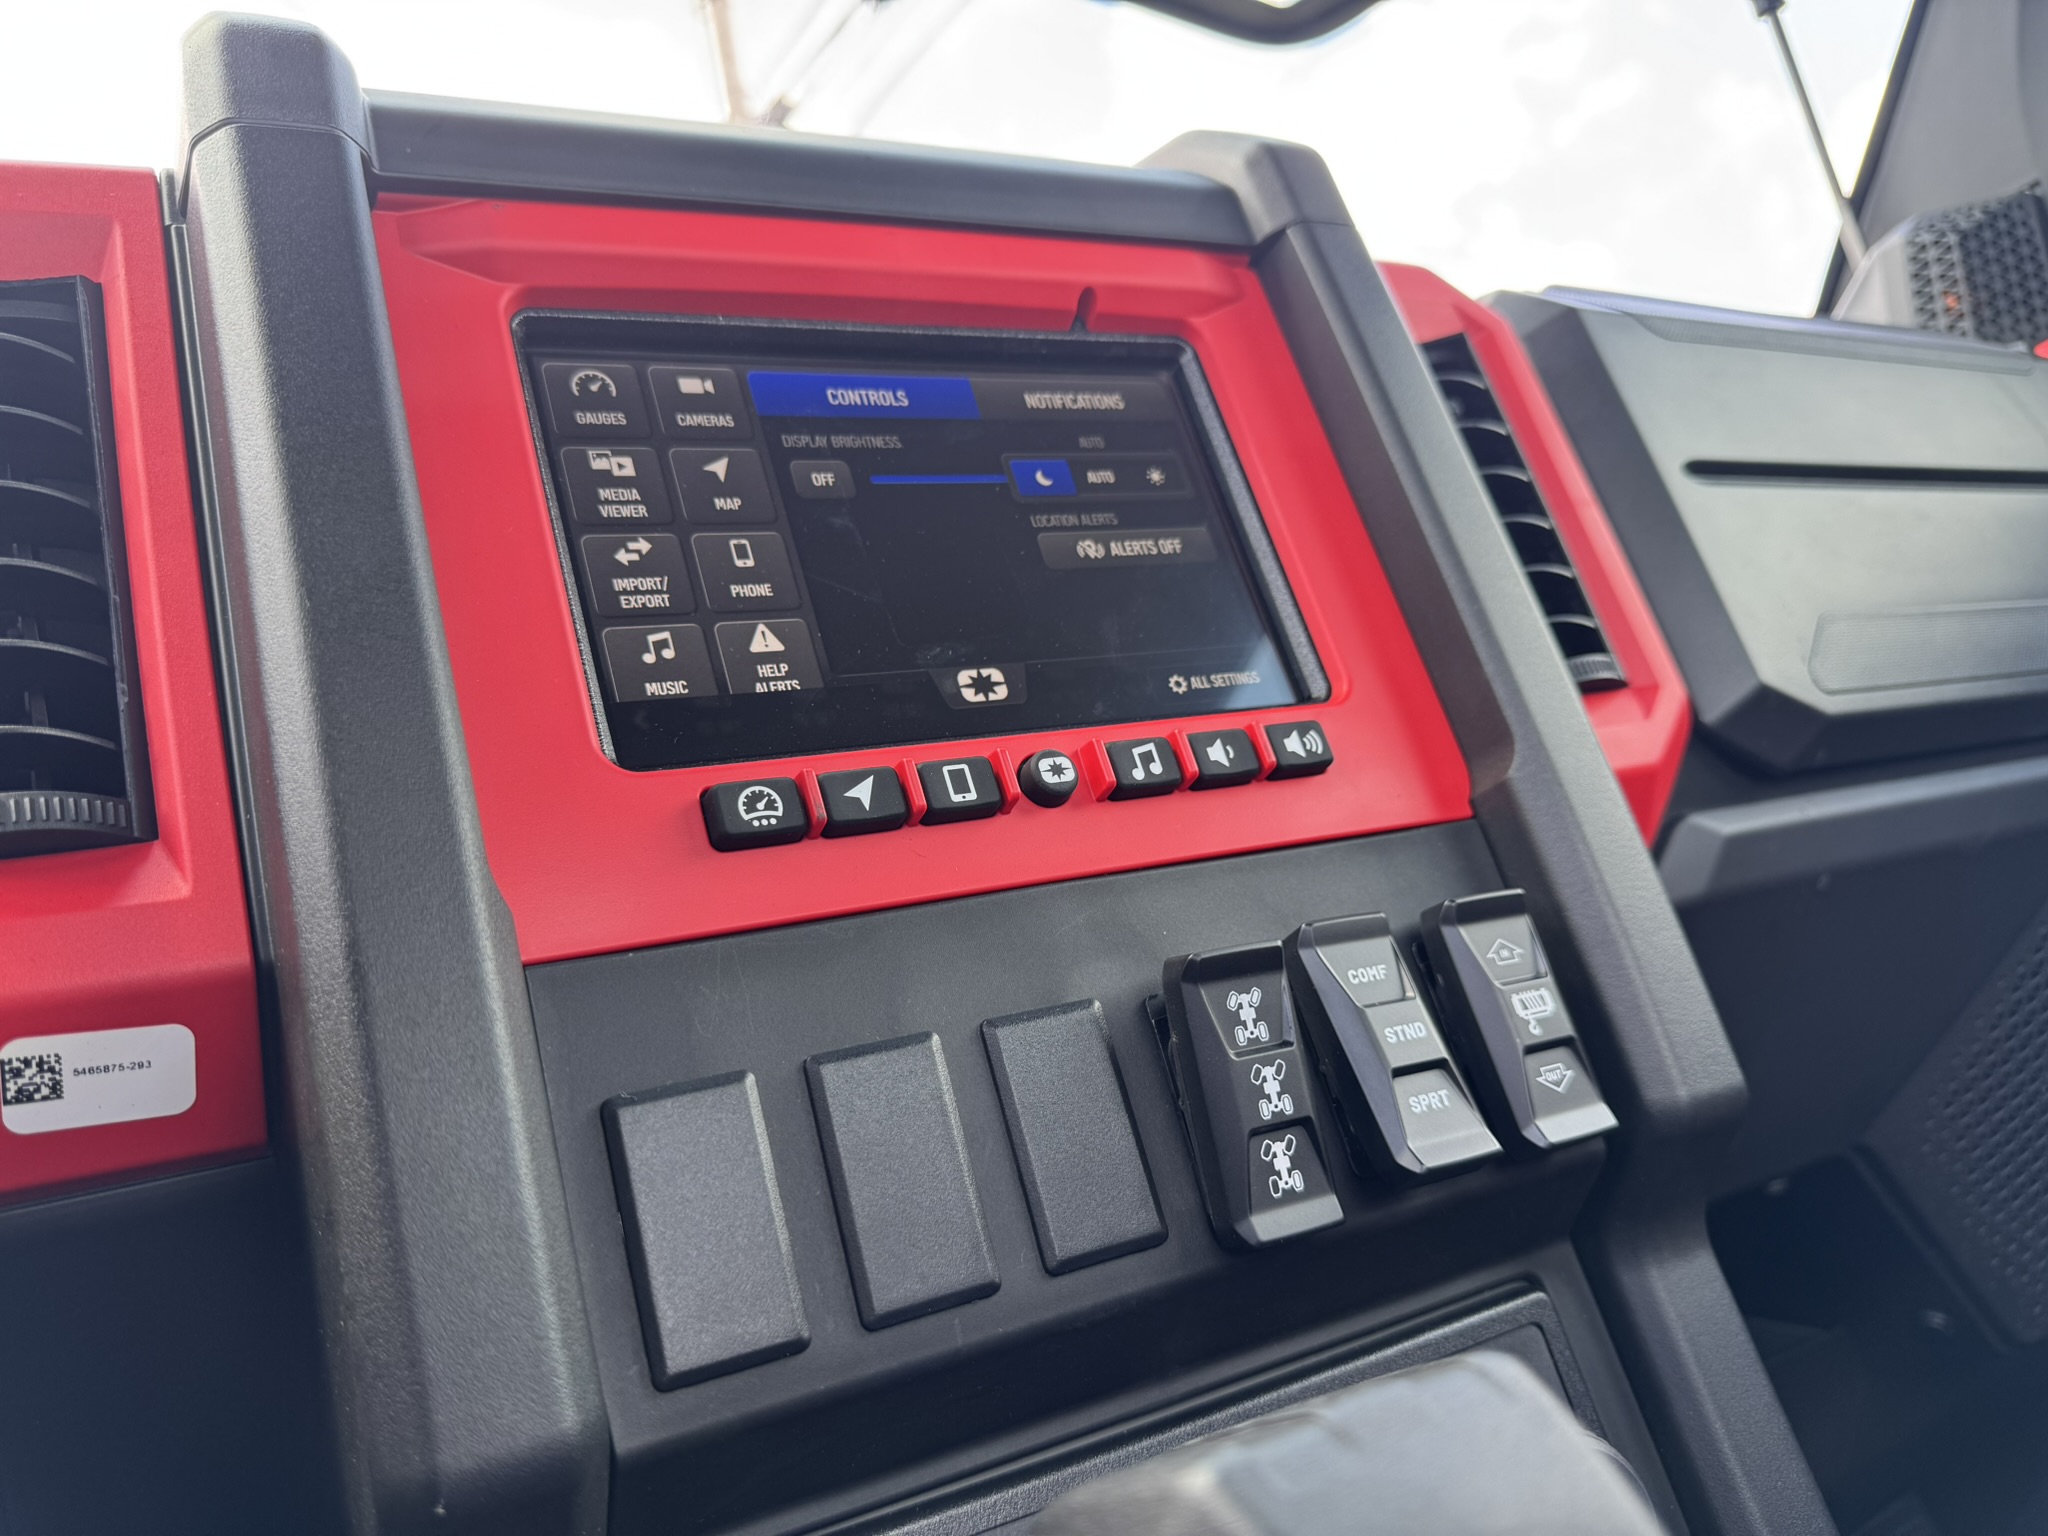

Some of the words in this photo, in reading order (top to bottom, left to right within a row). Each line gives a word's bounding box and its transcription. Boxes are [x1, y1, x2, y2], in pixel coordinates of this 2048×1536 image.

[826, 388, 909, 407] CONTROLS
[1024, 391, 1126, 410] NOTIFICATIONS
[575, 411, 628, 426] GAUGES
[676, 413, 735, 428] CAMERAS
[781, 434, 828, 448] DISPLAY
[831, 435, 903, 449] BRIGHTNESS
[1078, 436, 1106, 449] AUTO
[810, 472, 836, 487] OFF
[1086, 468, 1116, 484] AUTO
[598, 488, 642, 502] MEDIA
[598, 504, 649, 519] VIEWER
[714, 497, 742, 512] MAP
[1030, 514, 1079, 528] LOCATION
[1080, 512, 1119, 526] ALERTS
[1109, 539, 1158, 557] ALERTS
[1157, 537, 1183, 554] OFF
[612, 576, 668, 592] IMPORT/
[730, 583, 774, 599] PHONE
[620, 593, 671, 609] EXPORT
[756, 663, 789, 678] HELP
[644, 680, 689, 696] MUSIC
[1190, 675, 1211, 690] ALL
[1210, 671, 1261, 688] SETTINGS
[1499, 948, 1510, 958] IN
[1347, 964, 1389, 984] COMF
[1383, 1022, 1425, 1043] STND
[73, 1060, 152, 1076] 5465875-293
[1545, 1069, 1562, 1081] OUT
[1409, 1090, 1450, 1113] SPRT
